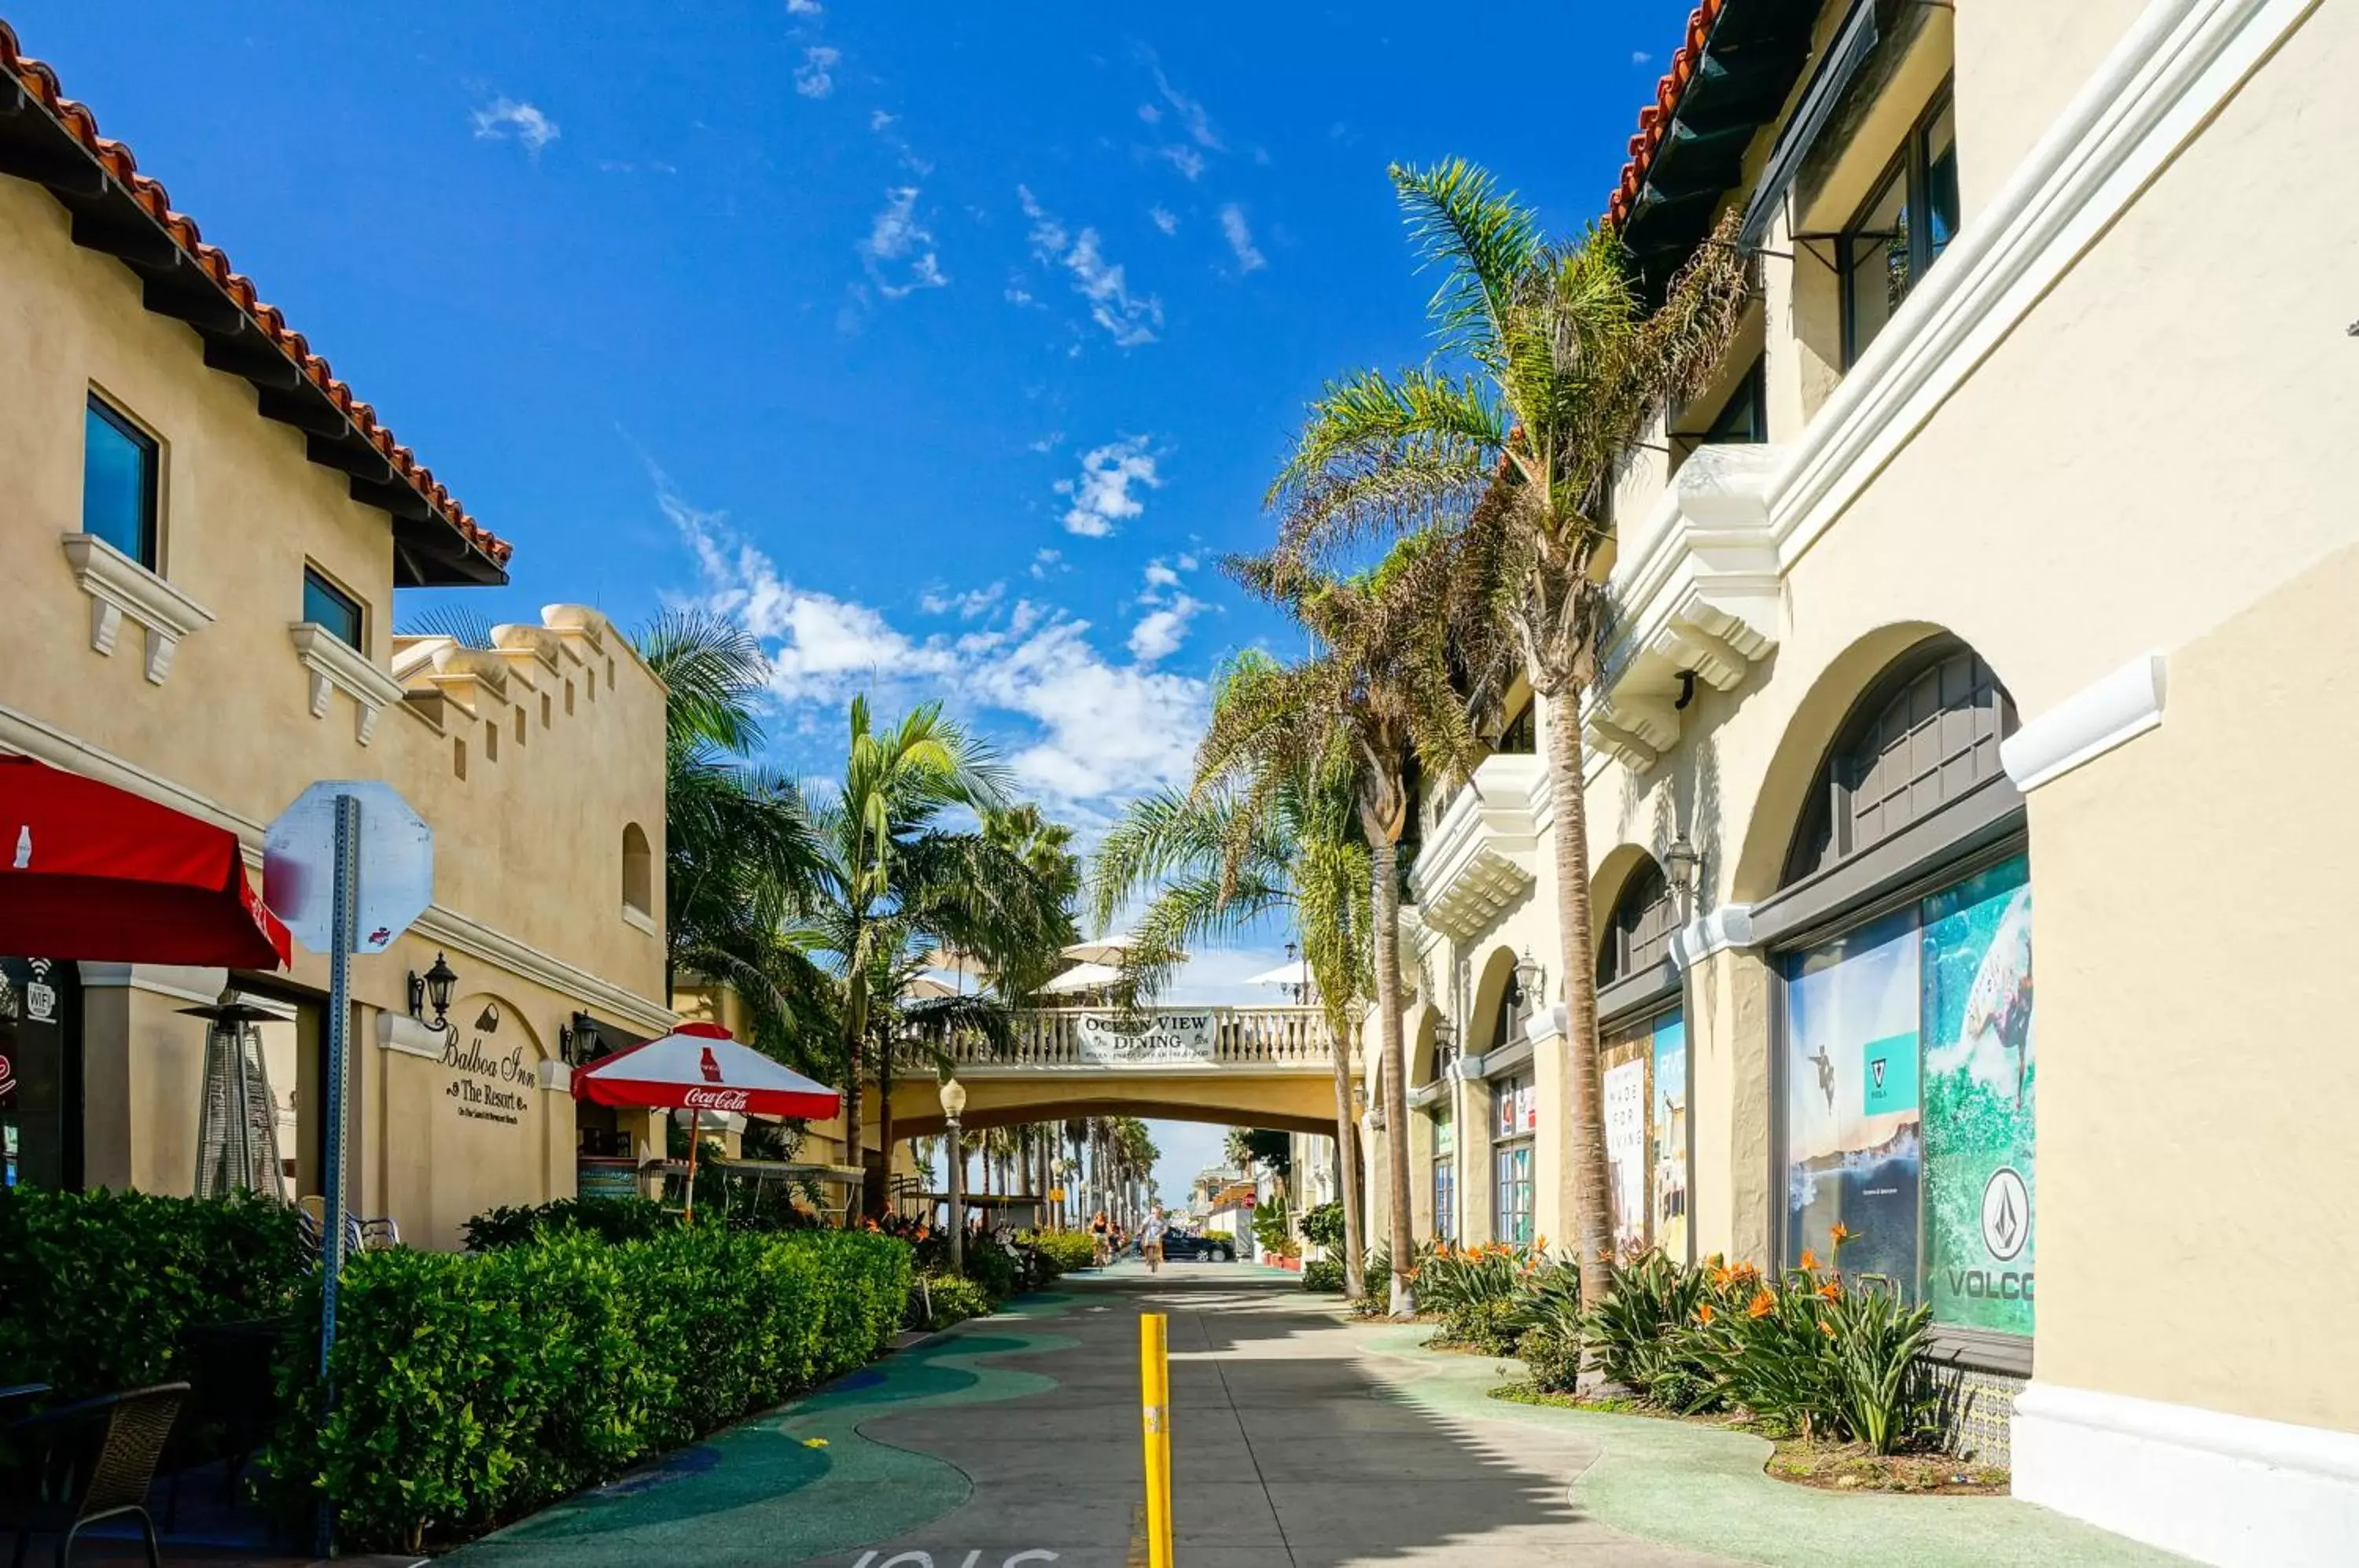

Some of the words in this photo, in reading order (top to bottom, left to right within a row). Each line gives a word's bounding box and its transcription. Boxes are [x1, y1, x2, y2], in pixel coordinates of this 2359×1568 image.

[1086, 1018, 1152, 1033] OCEAN
[1157, 1016, 1208, 1030] VIEW
[1113, 1035, 1182, 1050] DINING
[440, 1023, 498, 1077] Balboa
[501, 1046, 535, 1089] Inn
[461, 1079, 482, 1103] The
[484, 1084, 515, 1110] Resort
[1610, 1129, 1642, 1151] IVING
